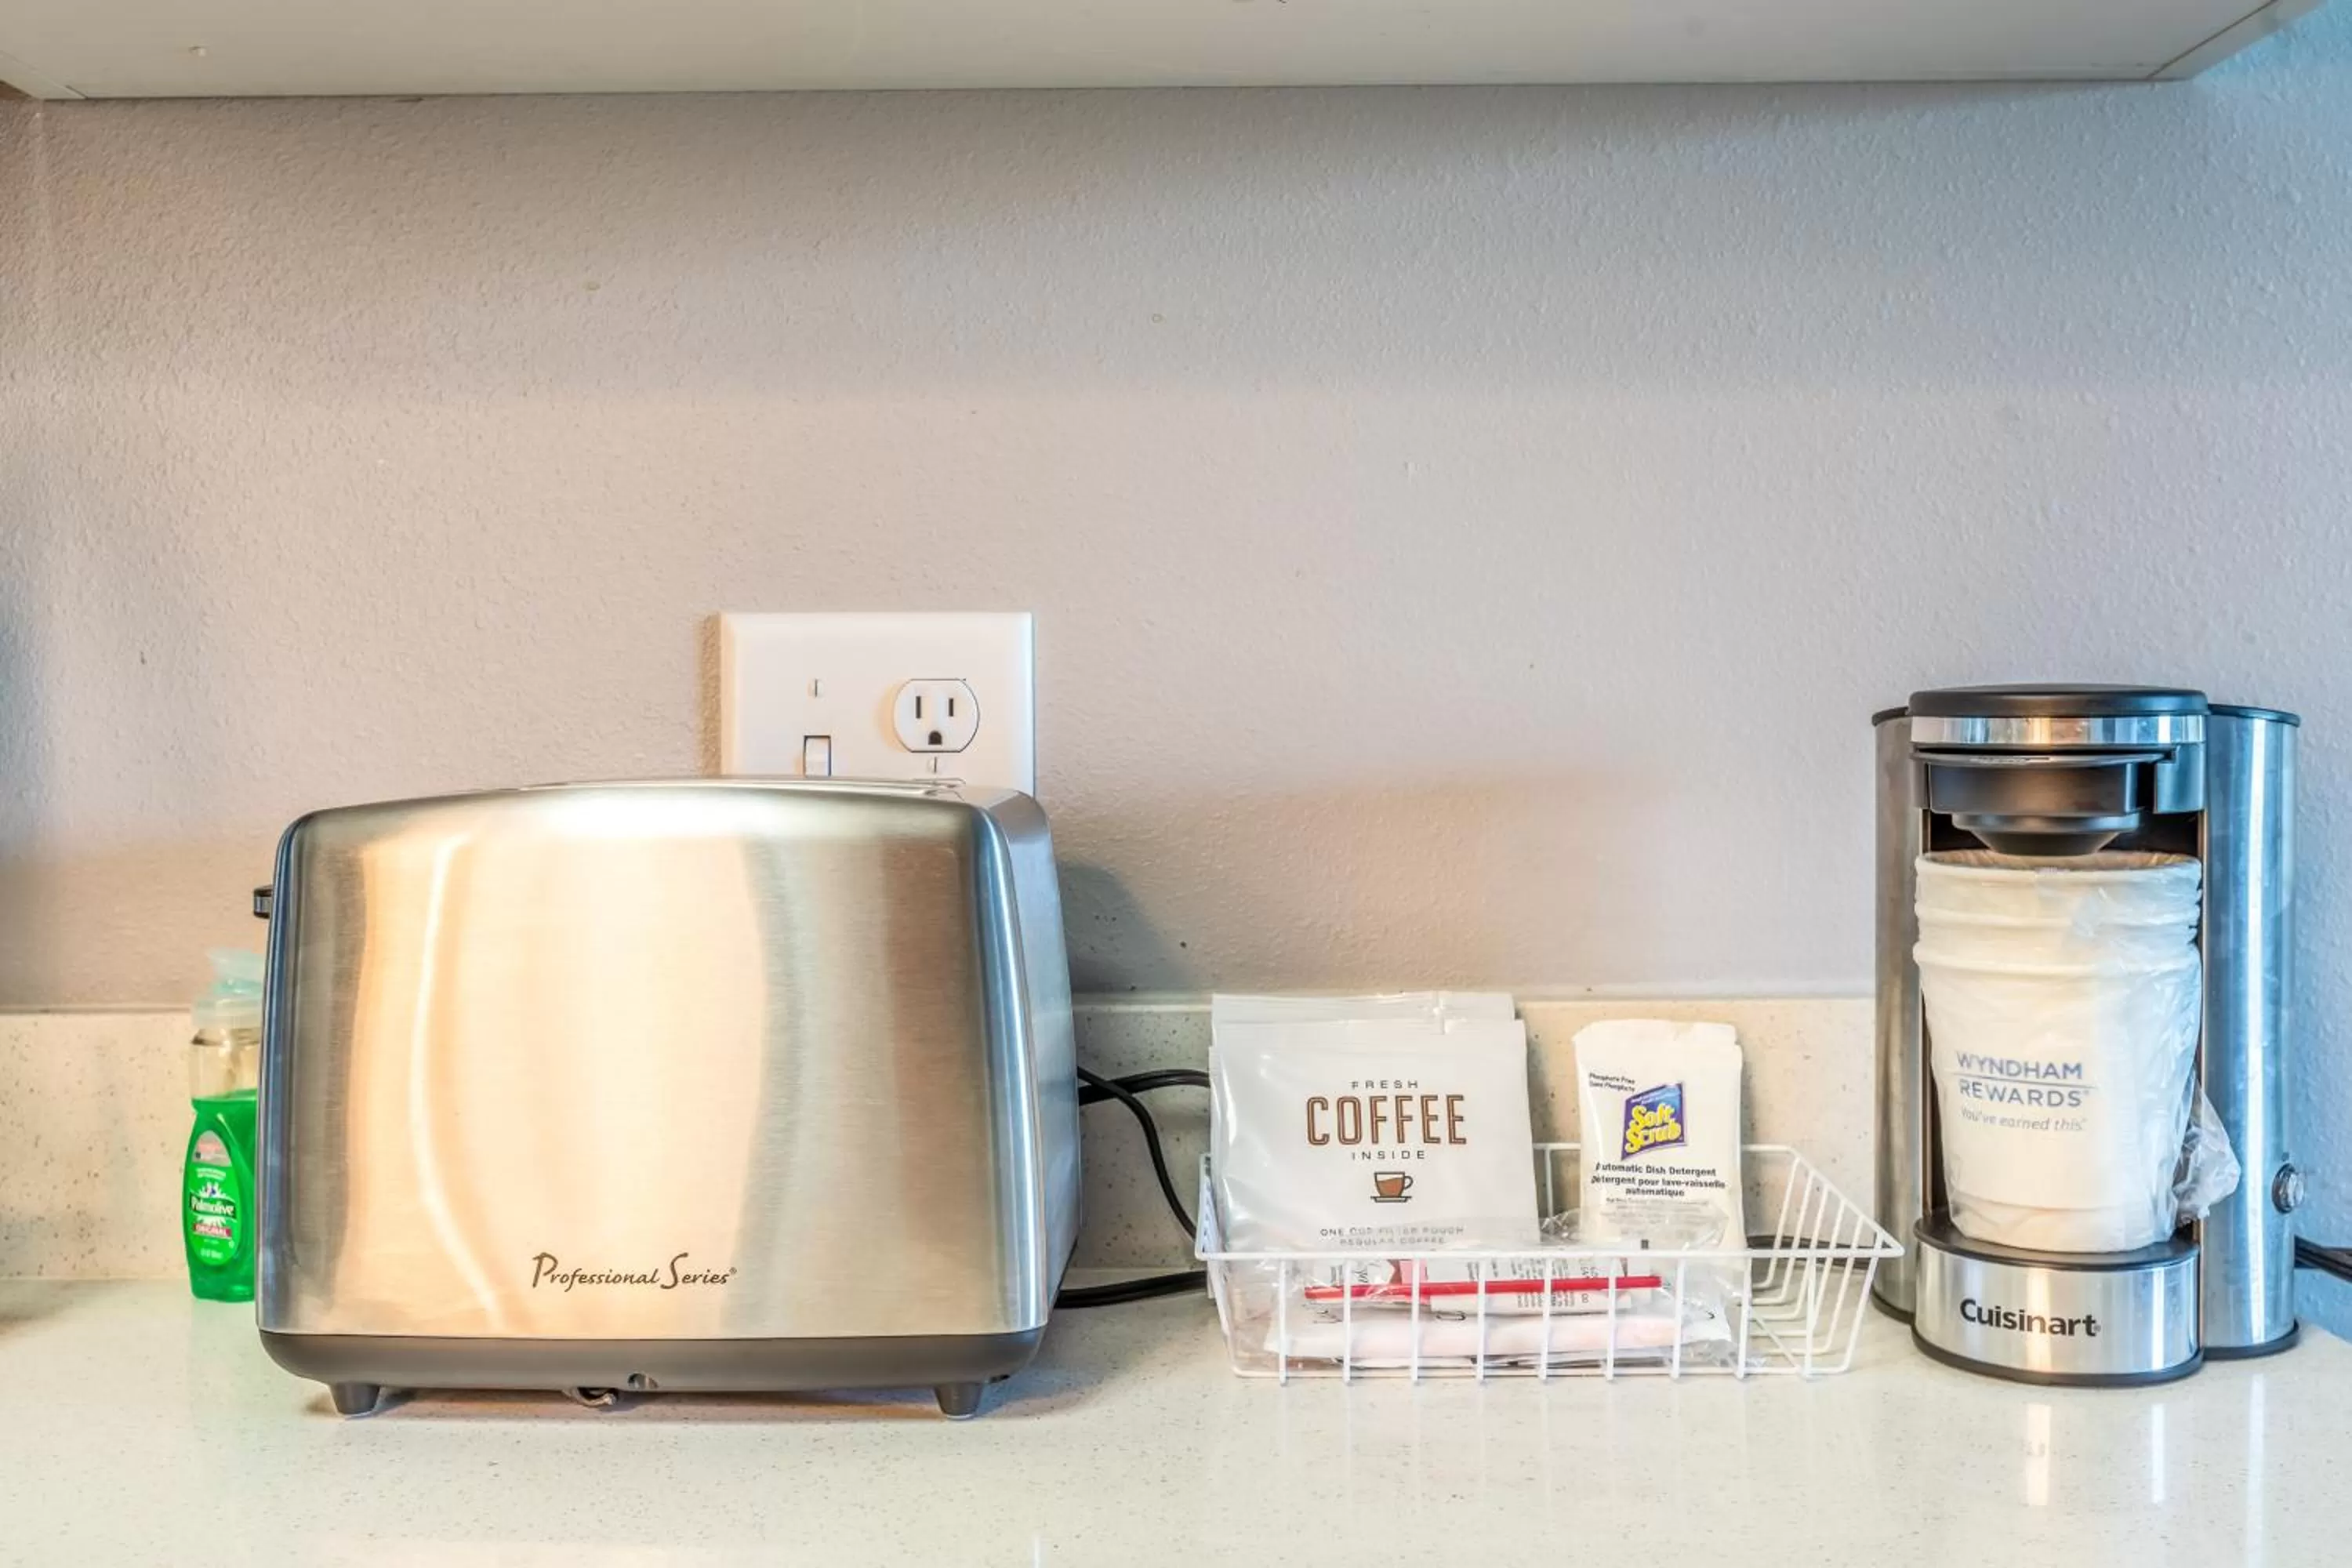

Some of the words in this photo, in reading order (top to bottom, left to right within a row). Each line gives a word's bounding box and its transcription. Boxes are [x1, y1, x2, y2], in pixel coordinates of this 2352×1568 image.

[1956, 1051, 2082, 1080] WYNDHAM
[1349, 1080, 1418, 1090] FRESH
[1958, 1079, 2082, 1107] REWARDS
[1306, 1094, 1467, 1145] COFFEE
[1632, 1102, 1675, 1131] Soft
[2000, 1116, 2050, 1131] earned
[1624, 1120, 1682, 1153] Scrub
[1351, 1150, 1426, 1161] INSIDE
[1638, 1178, 1660, 1187] pour
[1646, 1165, 1666, 1174] Dish
[1669, 1167, 1716, 1178] Detergent
[1625, 1188, 1685, 1198] automatique
[532, 1252, 660, 1292] Professional
[660, 1252, 731, 1290] Series
[1959, 1298, 2096, 1337] Cuisinart
